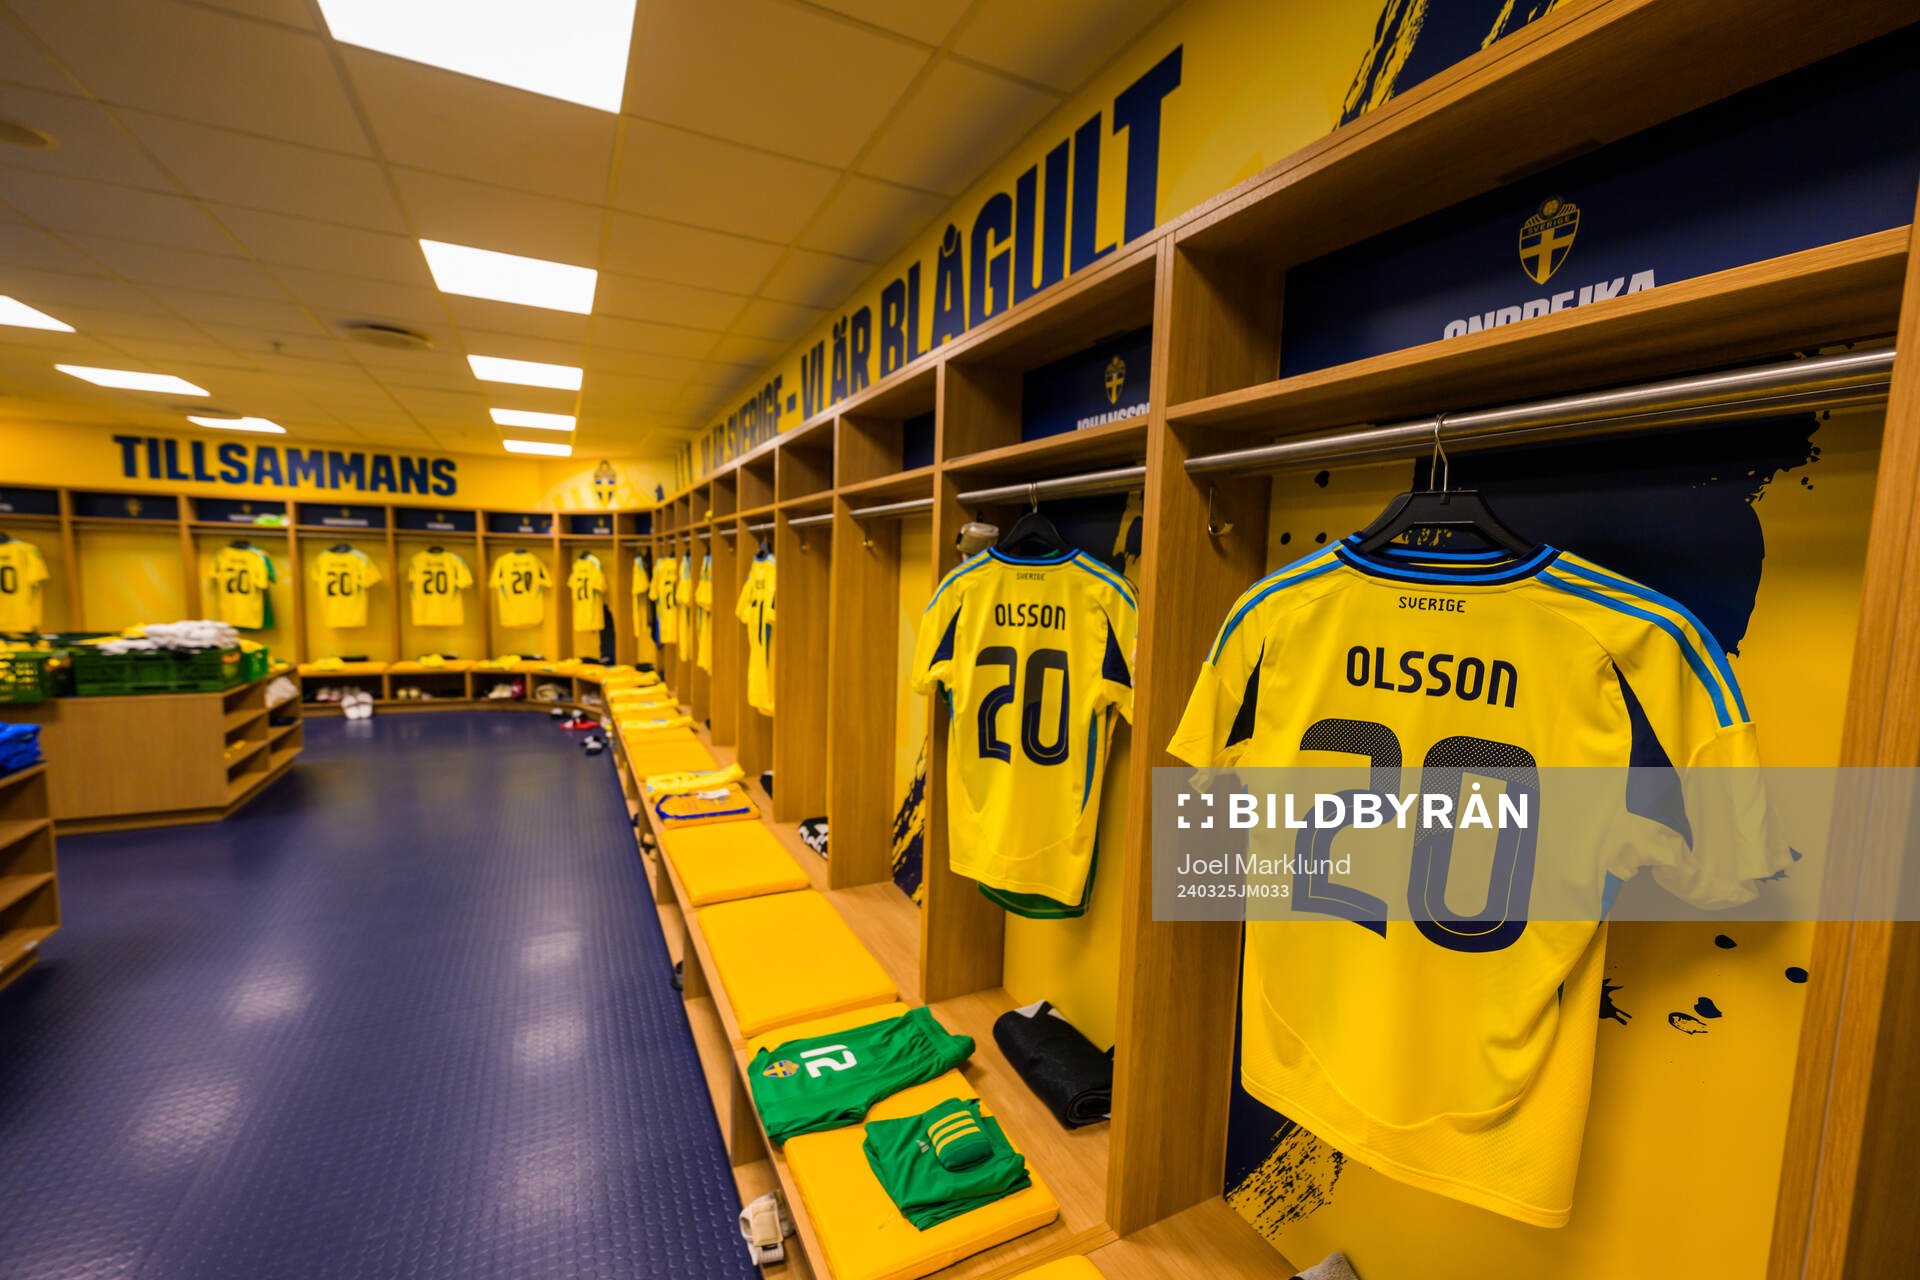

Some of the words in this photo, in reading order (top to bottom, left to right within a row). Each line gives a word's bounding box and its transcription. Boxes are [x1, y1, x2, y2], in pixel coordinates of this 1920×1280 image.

[800, 341, 825, 422] VI
[831, 305, 871, 406] ÄR
[880, 43, 1183, 379] BLÅGULT
[1526, 215, 1572, 235] SVERIGE
[113, 434, 458, 497] TILLSAMMANS
[327, 571, 353, 596] 20
[422, 570, 448, 595] 20
[1398, 596, 1466, 614] SVERIGE
[995, 603, 1066, 630] OLSSON
[1346, 644, 1519, 709] OLSSON
[975, 645, 1070, 767] 20
[1290, 717, 1541, 954] 20
